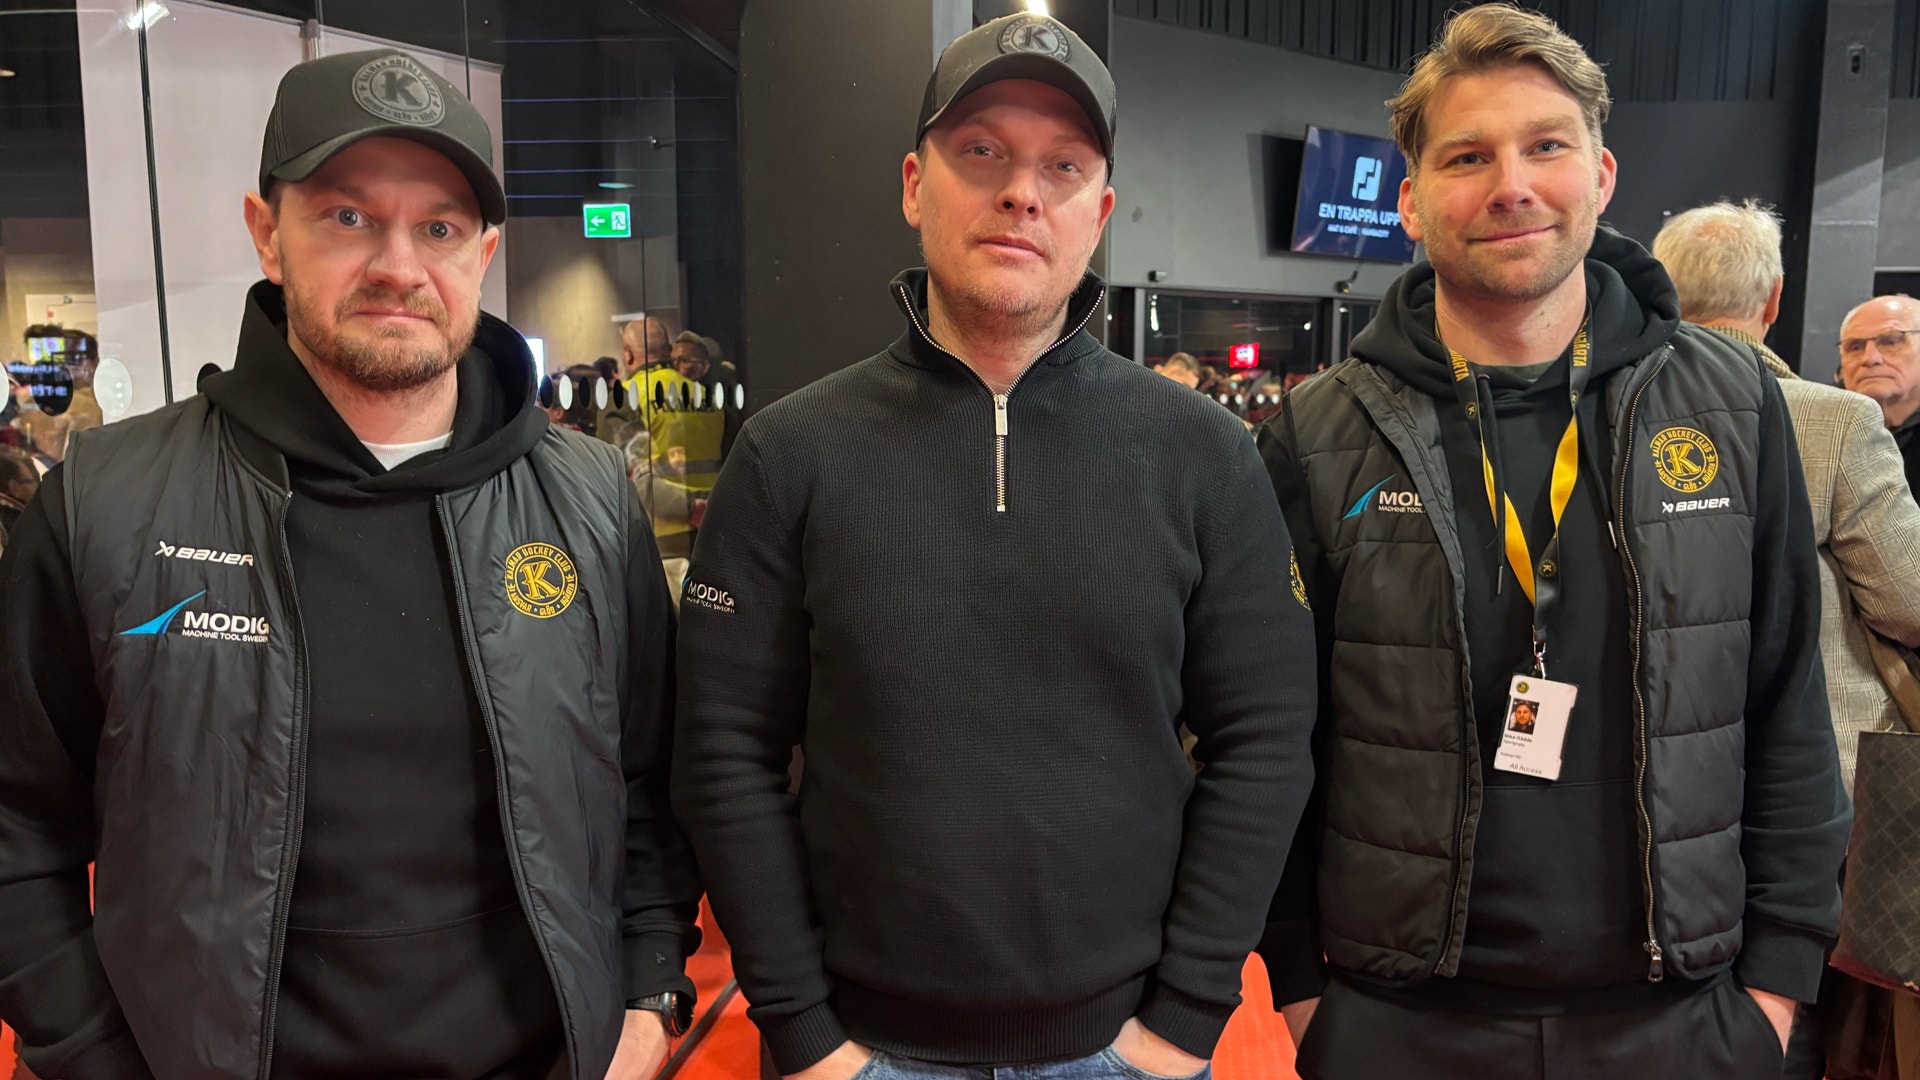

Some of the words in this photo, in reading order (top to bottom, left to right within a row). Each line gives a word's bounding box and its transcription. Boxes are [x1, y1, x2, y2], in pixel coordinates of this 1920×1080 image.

[380, 70, 423, 107] K
[1318, 202, 1337, 219] EN
[1337, 204, 1379, 224] TRAPPA
[1380, 210, 1400, 227] UPP
[1666, 430, 1697, 440] HOCKEY
[1664, 442, 1702, 477] K
[1378, 505, 1406, 513] MACHINE
[1406, 506, 1423, 514] TOOL
[1675, 497, 1731, 512] BAUER
[175, 547, 254, 567] BAUER
[506, 551, 523, 580] KALMAR
[521, 546, 554, 557] HOCKEY
[554, 553, 572, 572] CLUB
[519, 560, 560, 600] K
[687, 580, 735, 607] MODIG
[183, 610, 270, 635] MODIG
[181, 629, 219, 640] MACHINE
[220, 631, 242, 642] TOOL
[1509, 762, 1519, 770] All
[1519, 764, 1543, 775] Access
